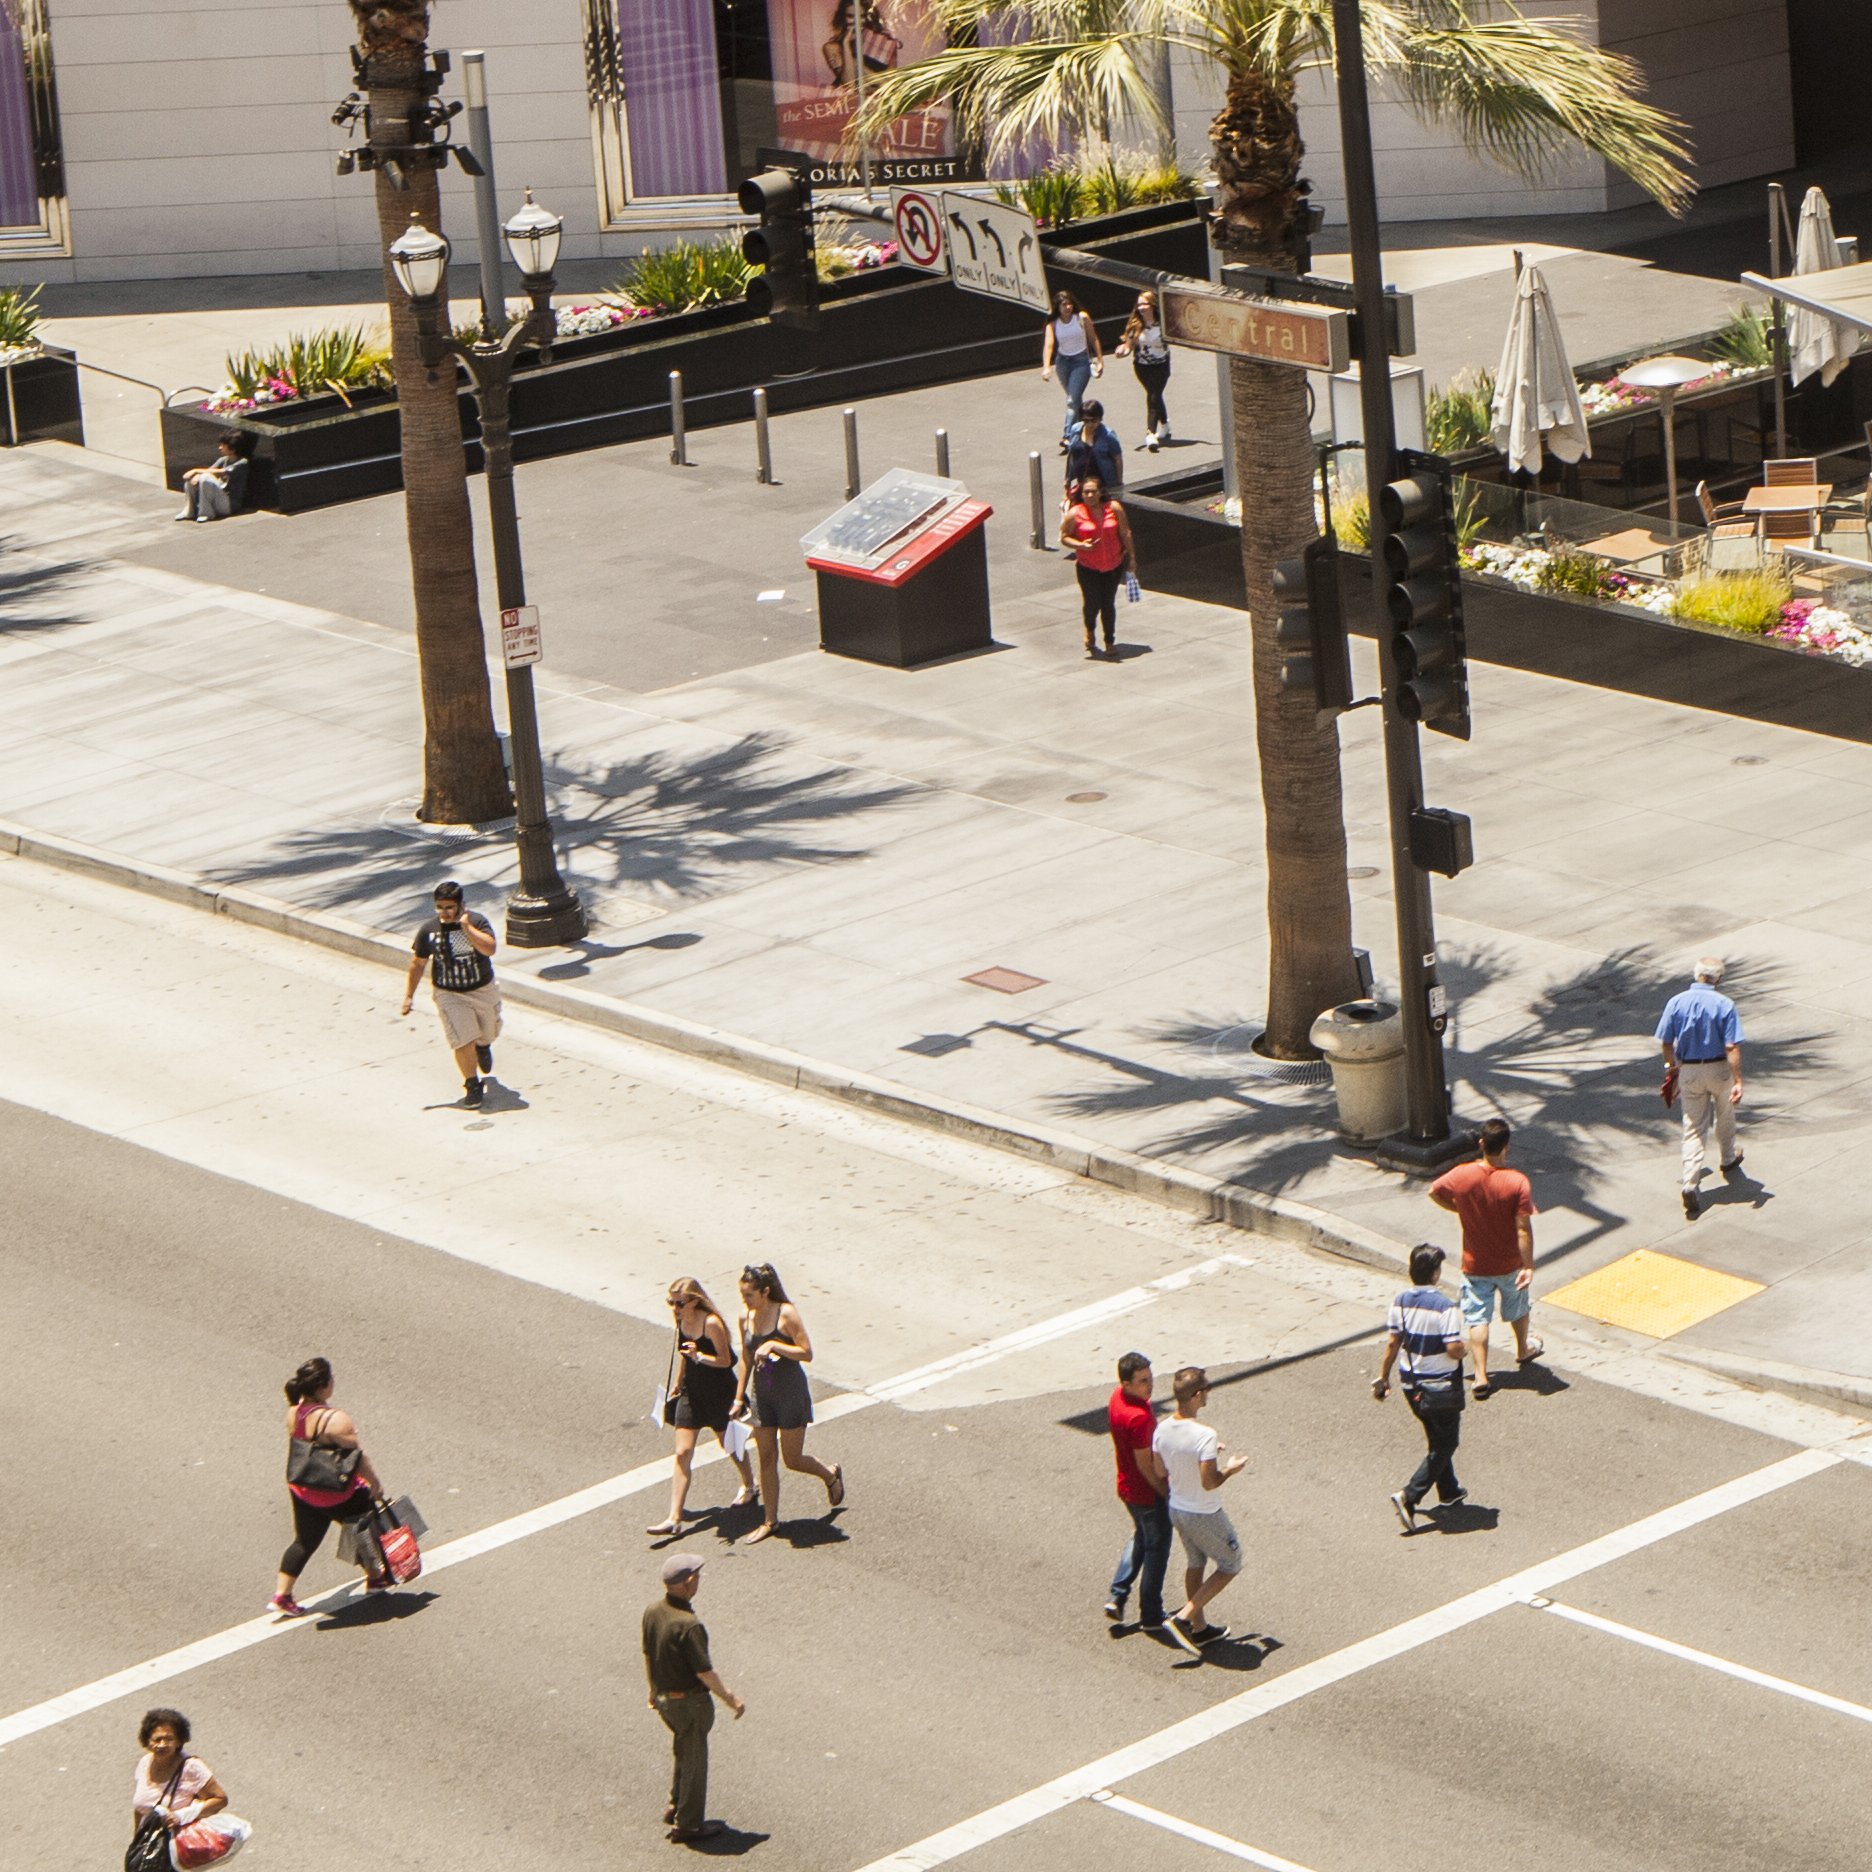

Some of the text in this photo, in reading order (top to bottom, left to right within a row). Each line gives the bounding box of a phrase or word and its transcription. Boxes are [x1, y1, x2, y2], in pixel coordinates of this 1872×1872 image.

[783, 110, 801, 124] the
[872, 117, 939, 150] ALE
[883, 162, 956, 179] SECRET
[956, 265, 1045, 300] ONLY ONLY ONLY
[1184, 301, 1308, 354] Central
[503, 611, 517, 627] NO
[505, 625, 538, 642] STOPPING
